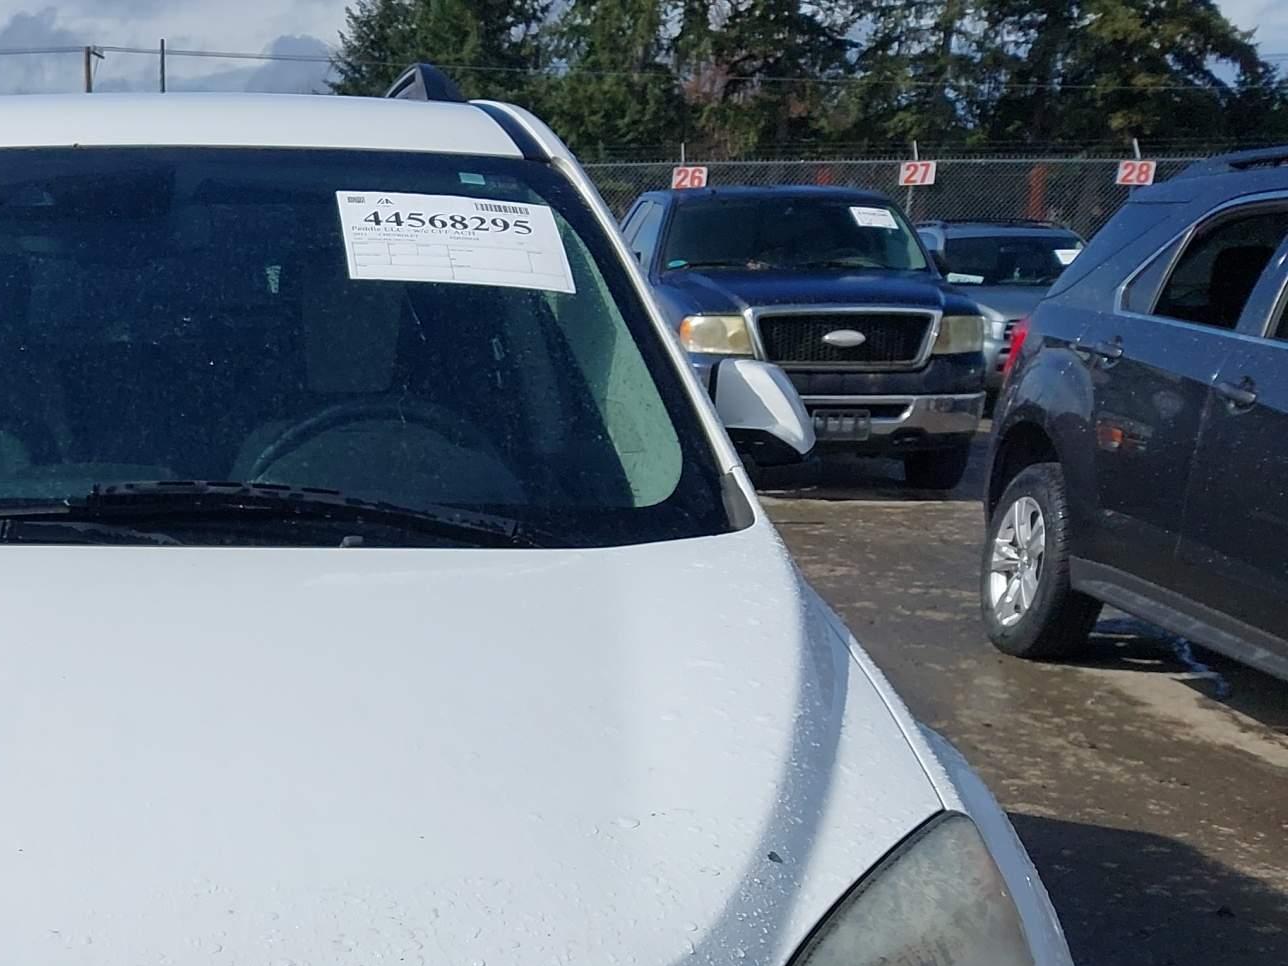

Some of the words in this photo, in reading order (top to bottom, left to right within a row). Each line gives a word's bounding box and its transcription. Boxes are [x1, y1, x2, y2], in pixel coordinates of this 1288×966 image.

[675, 168, 703, 188] 26
[904, 163, 930, 184] 27
[1122, 162, 1150, 183] 28
[363, 210, 532, 235] 44568295
